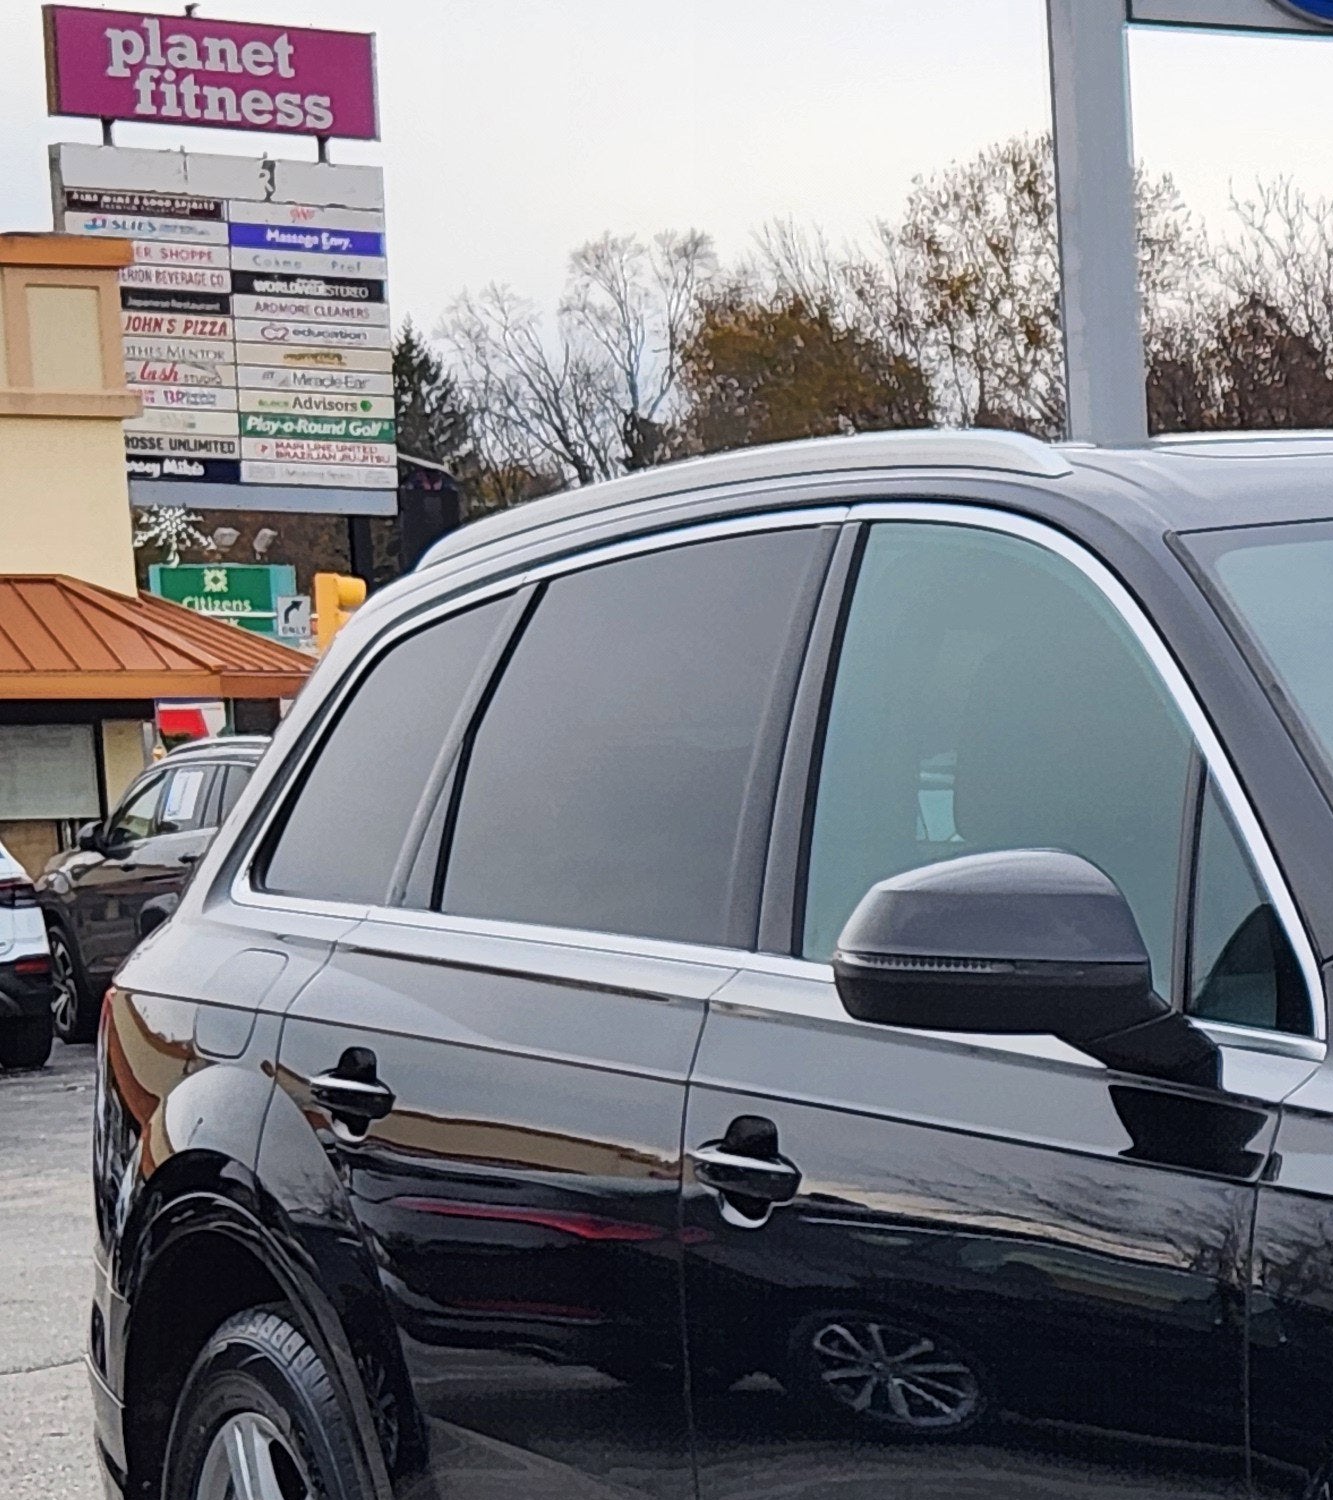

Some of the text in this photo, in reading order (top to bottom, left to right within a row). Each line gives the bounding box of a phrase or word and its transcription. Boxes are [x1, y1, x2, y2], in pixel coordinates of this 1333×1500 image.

[105, 18, 295, 79] planet
[134, 69, 334, 131] fitness
[161, 247, 213, 262] SHOPPE
[155, 270, 206, 286] BEVERAGE
[254, 301, 370, 319] ARDMORE CLEANERS
[125, 316, 228, 336] JOHNS PIZZA
[292, 328, 367, 340] education
[140, 361, 179, 381] Lash
[292, 396, 358, 412] Advisors
[349, 421, 382, 437] Golf
[169, 438, 235, 454] UNLIMITED
[275, 450, 337, 460] BRAZILIAN
[182, 595, 252, 613] Citizens
